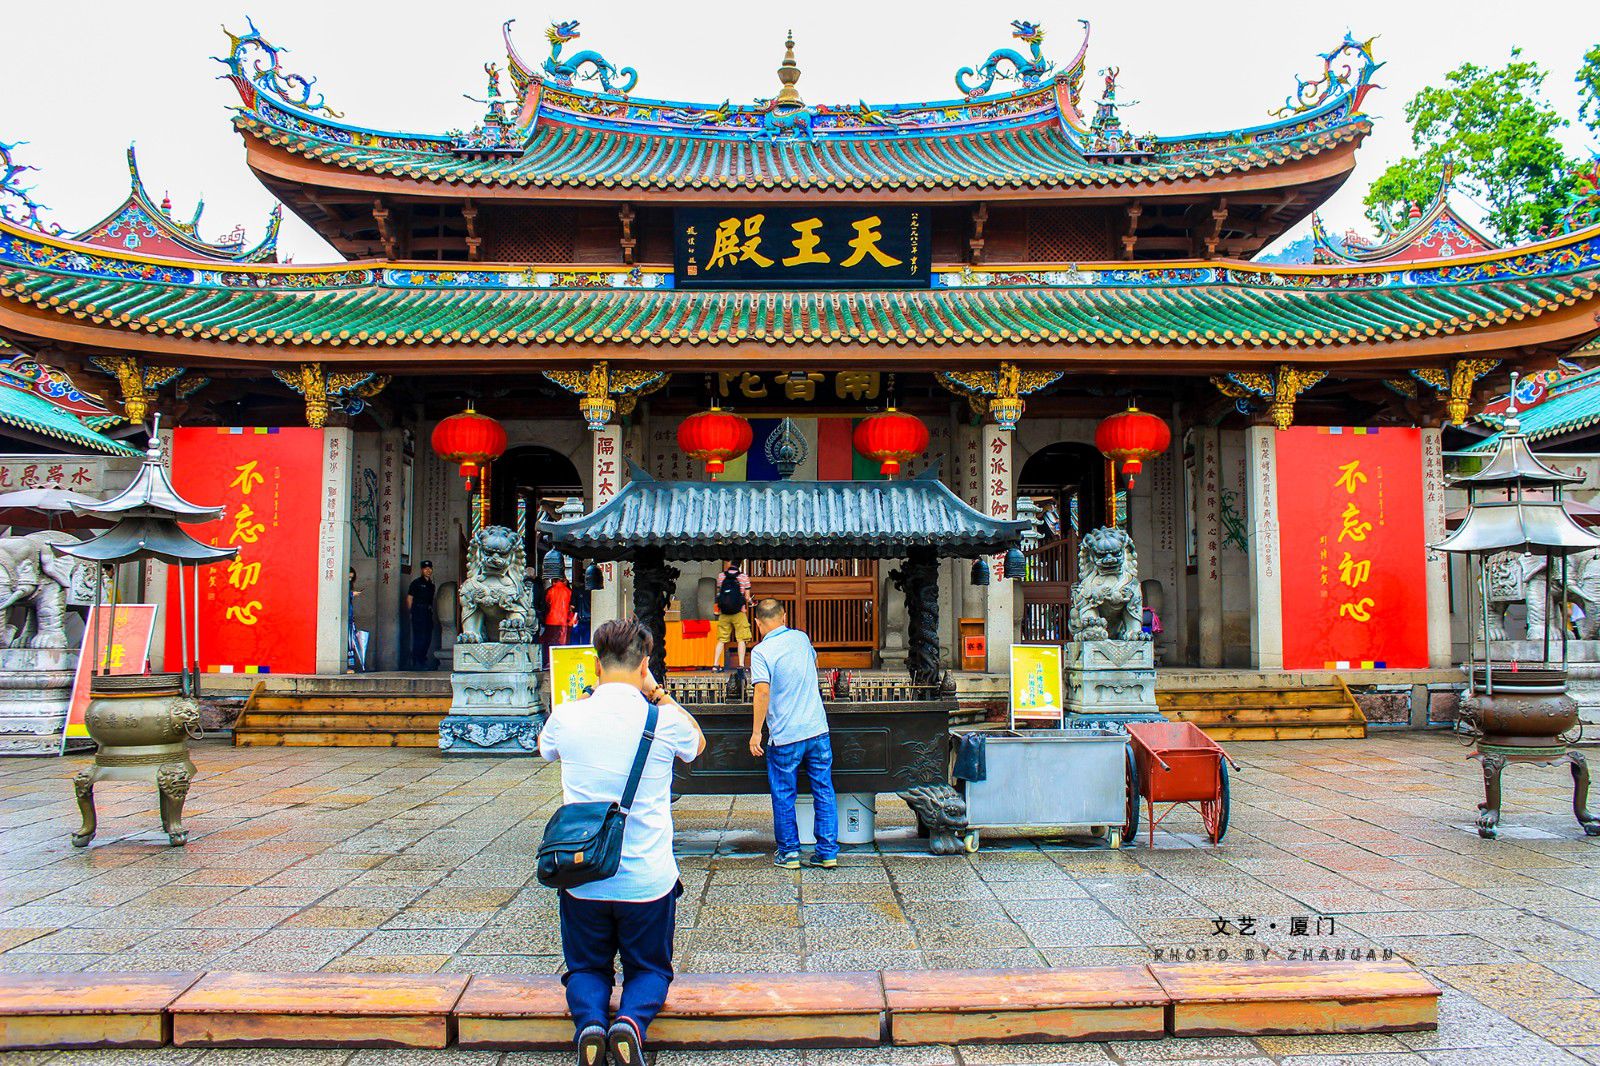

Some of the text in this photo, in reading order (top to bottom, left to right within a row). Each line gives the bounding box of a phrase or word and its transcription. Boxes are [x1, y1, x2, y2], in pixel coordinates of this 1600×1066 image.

[705, 213, 903, 271] 天王殿
[597, 437, 615, 508] 隔江太
[226, 460, 266, 625] 不忘初心
[1334, 460, 1375, 622] 不忘初心
